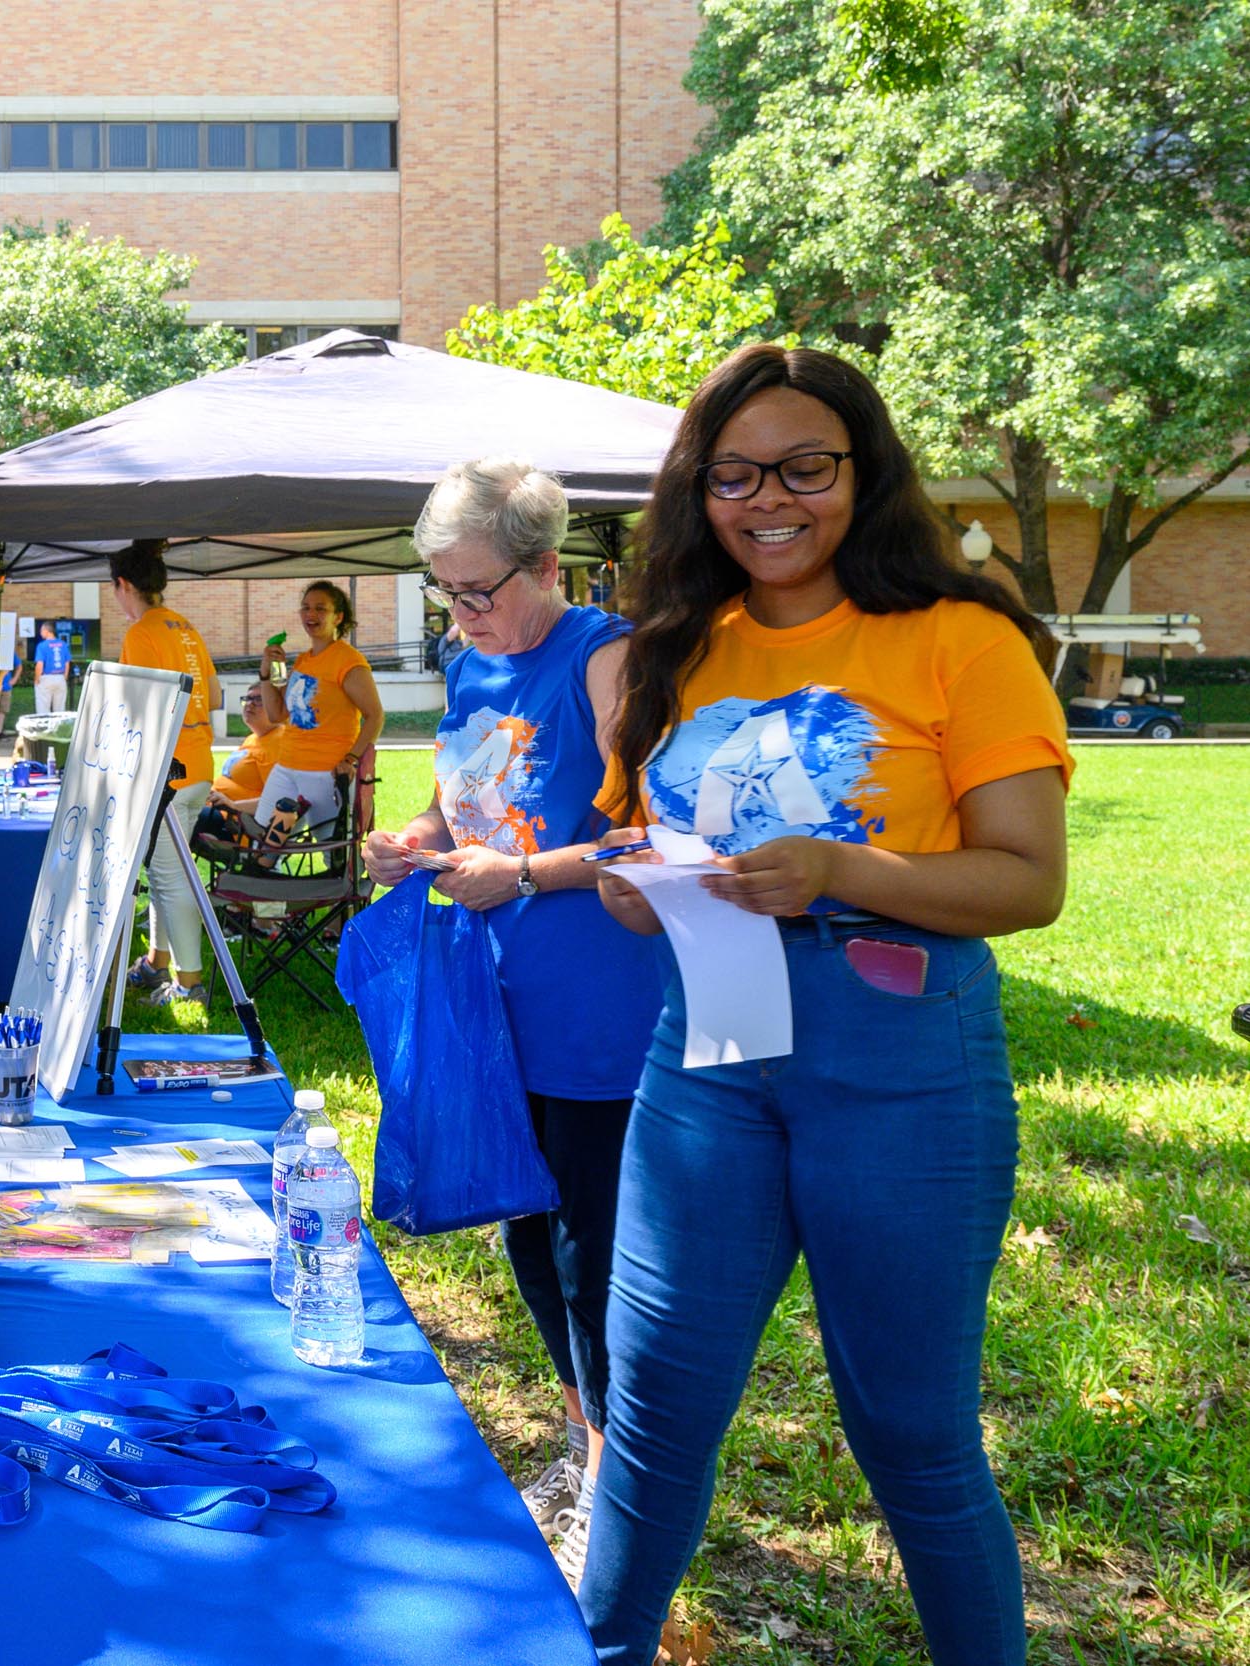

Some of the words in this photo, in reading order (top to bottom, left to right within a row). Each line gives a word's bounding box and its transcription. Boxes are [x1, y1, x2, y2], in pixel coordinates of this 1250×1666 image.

[502, 826, 519, 841] OF
[166, 1080, 190, 1089] EXPO
[302, 1219, 321, 1234] Life
